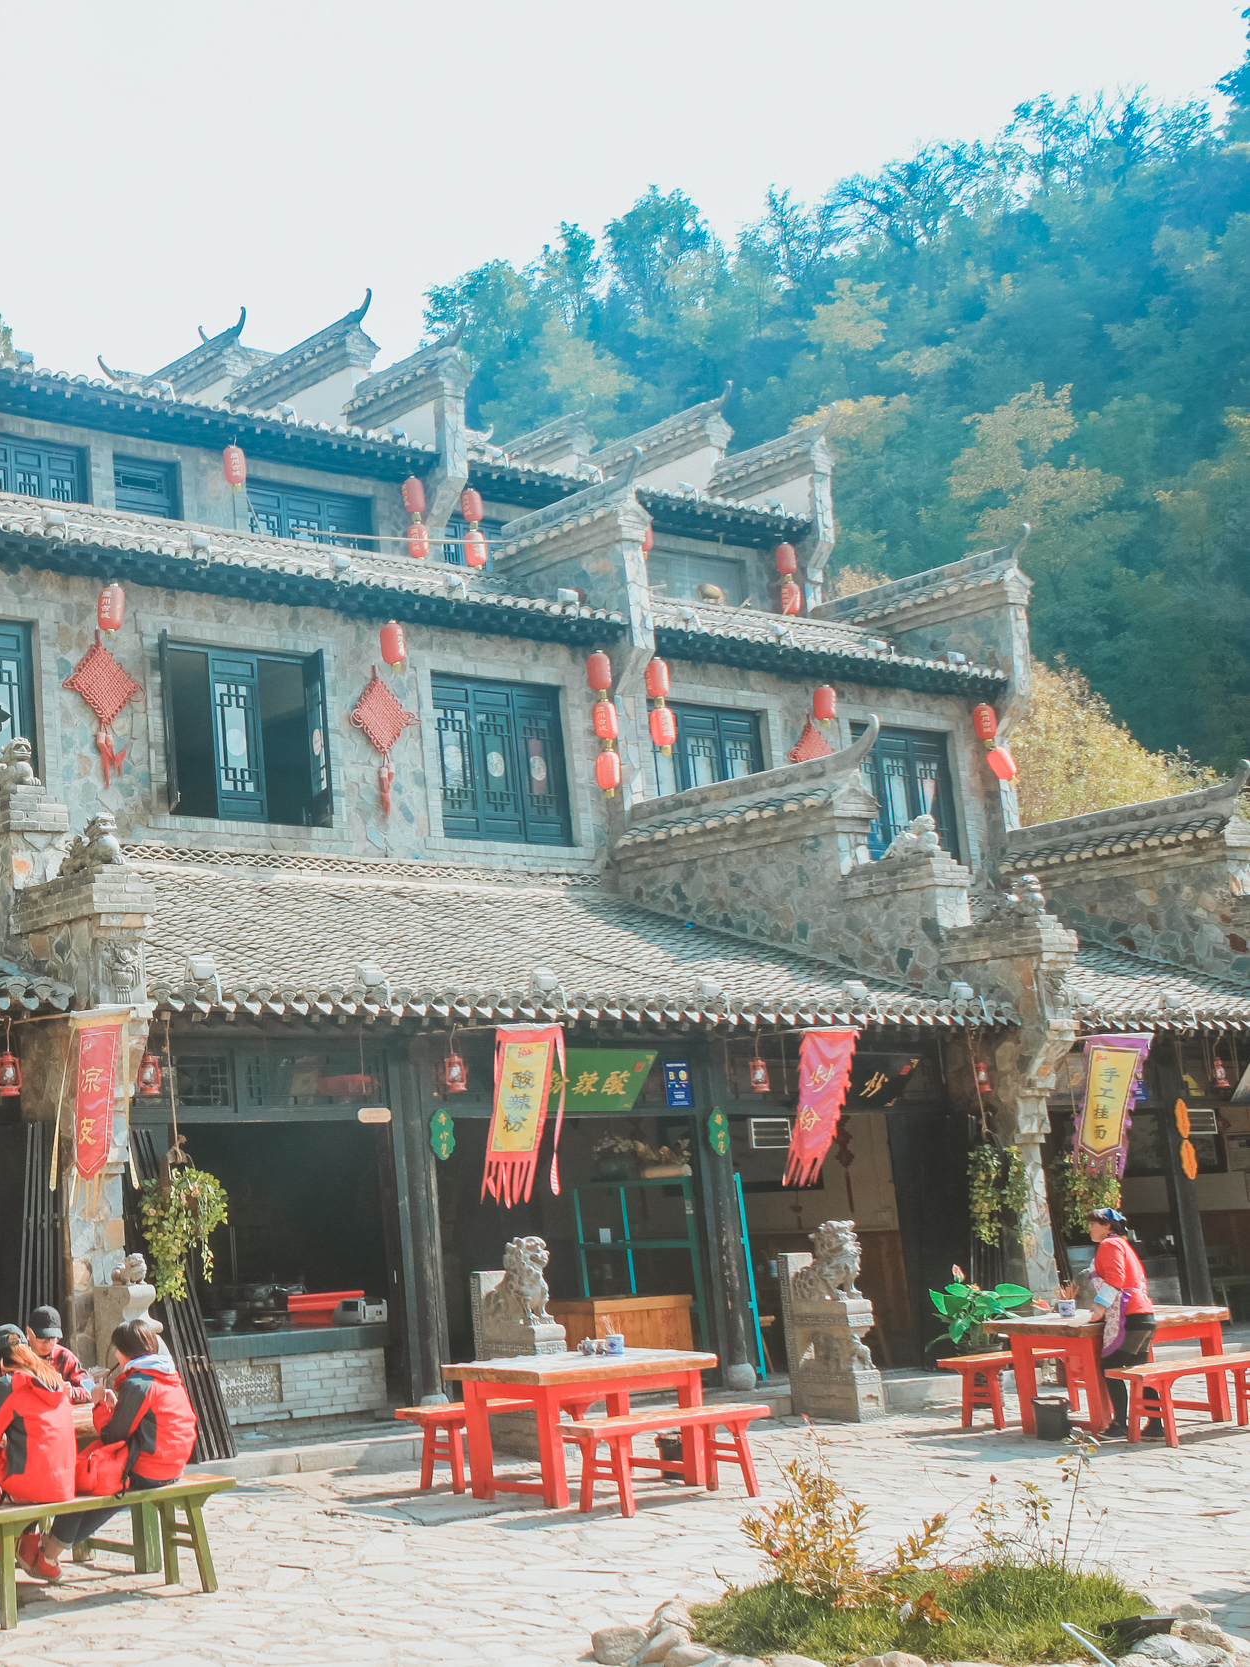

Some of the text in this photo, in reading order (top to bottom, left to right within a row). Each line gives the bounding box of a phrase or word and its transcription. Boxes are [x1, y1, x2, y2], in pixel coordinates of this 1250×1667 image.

[78, 1065, 105, 1146] 凉皮
[502, 1069, 536, 1133] 酸辣粉
[668, 1071, 676, 1081] B
[799, 1063, 836, 1132] 炒粉
[1093, 1066, 1121, 1141] 手工挂面
